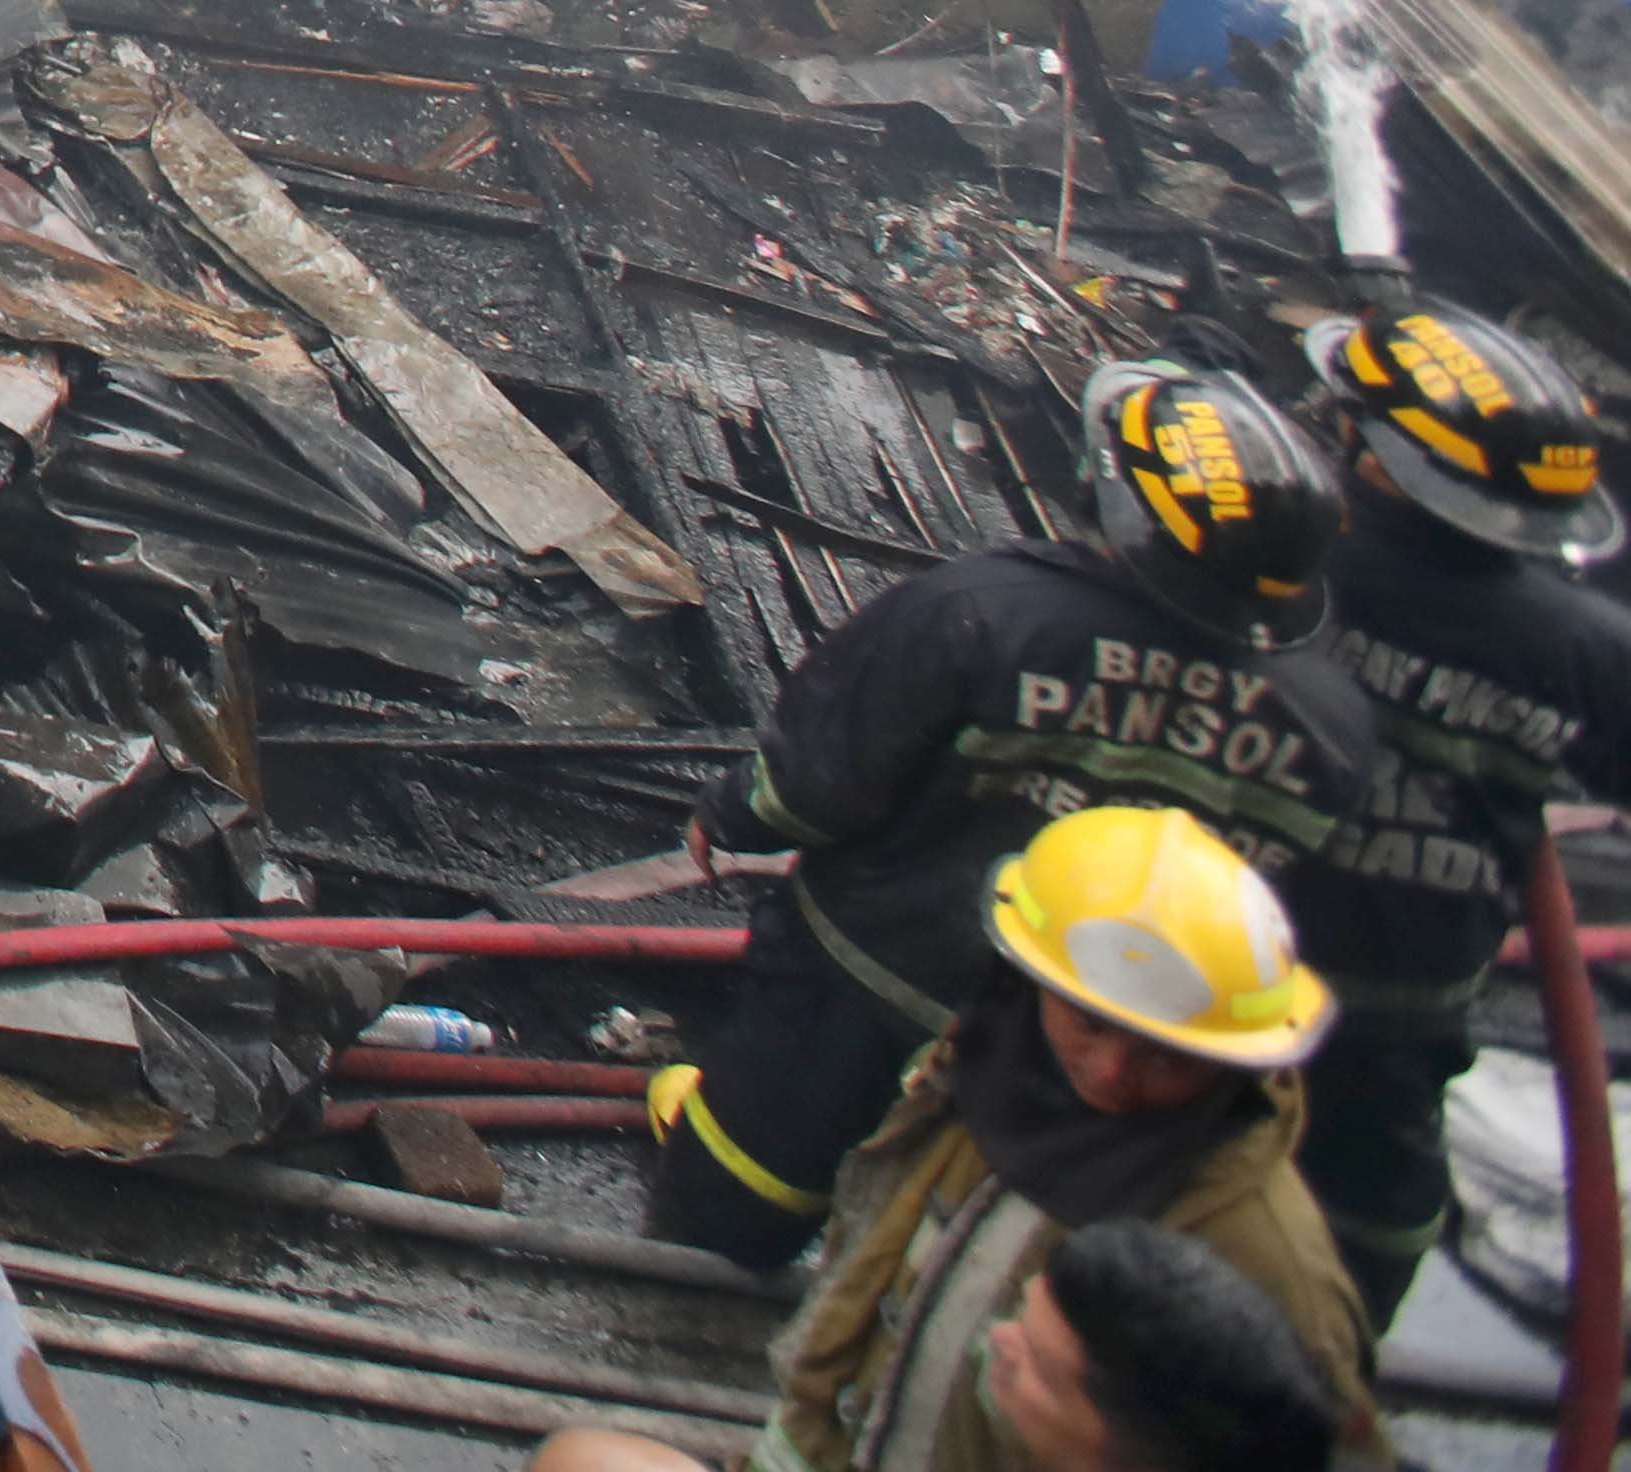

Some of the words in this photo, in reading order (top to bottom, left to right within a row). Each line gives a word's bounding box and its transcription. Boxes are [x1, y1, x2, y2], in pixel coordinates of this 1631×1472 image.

[1175, 401, 1252, 521] PANSOL
[1017, 671, 1313, 795] PANSOL
[1094, 636, 1272, 715] BRGY
